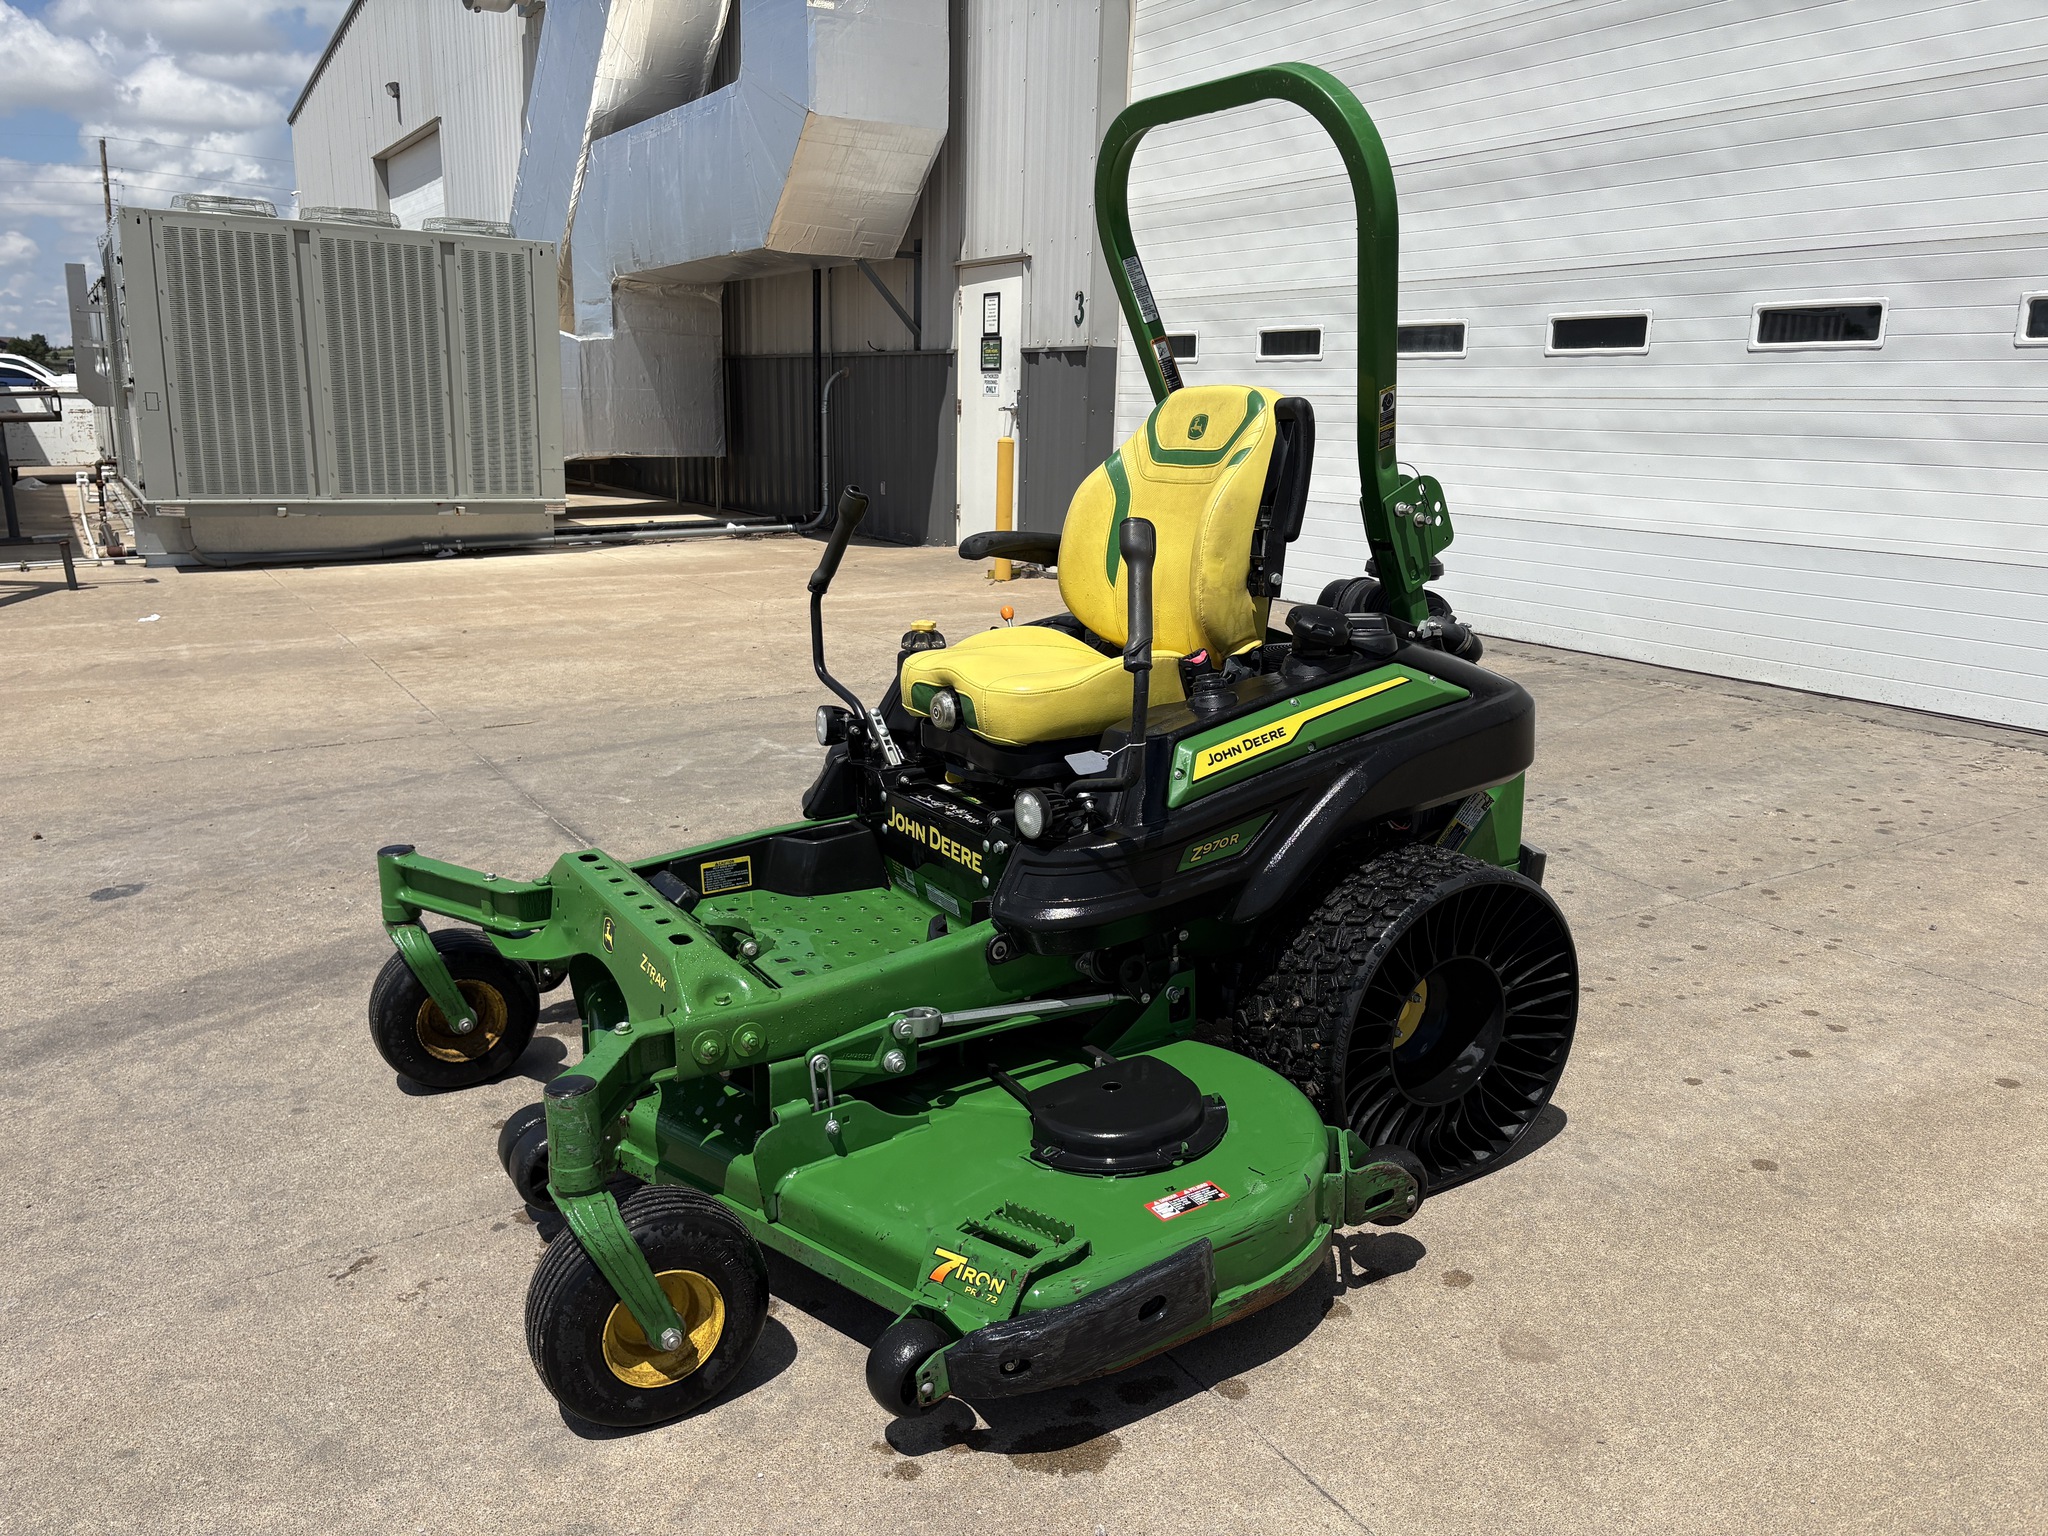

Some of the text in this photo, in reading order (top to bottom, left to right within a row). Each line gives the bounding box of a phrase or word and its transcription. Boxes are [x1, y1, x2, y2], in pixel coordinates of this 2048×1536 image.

[1074, 290, 1085, 328] 3
[985, 385, 997, 394] ONLY
[1207, 726, 1287, 767] JOHN DEERE
[887, 806, 983, 874] JOHN DEERE
[1190, 833, 1240, 863] Z970R
[639, 953, 668, 993] ZTRAK
[985, 1293, 999, 1305] 72
